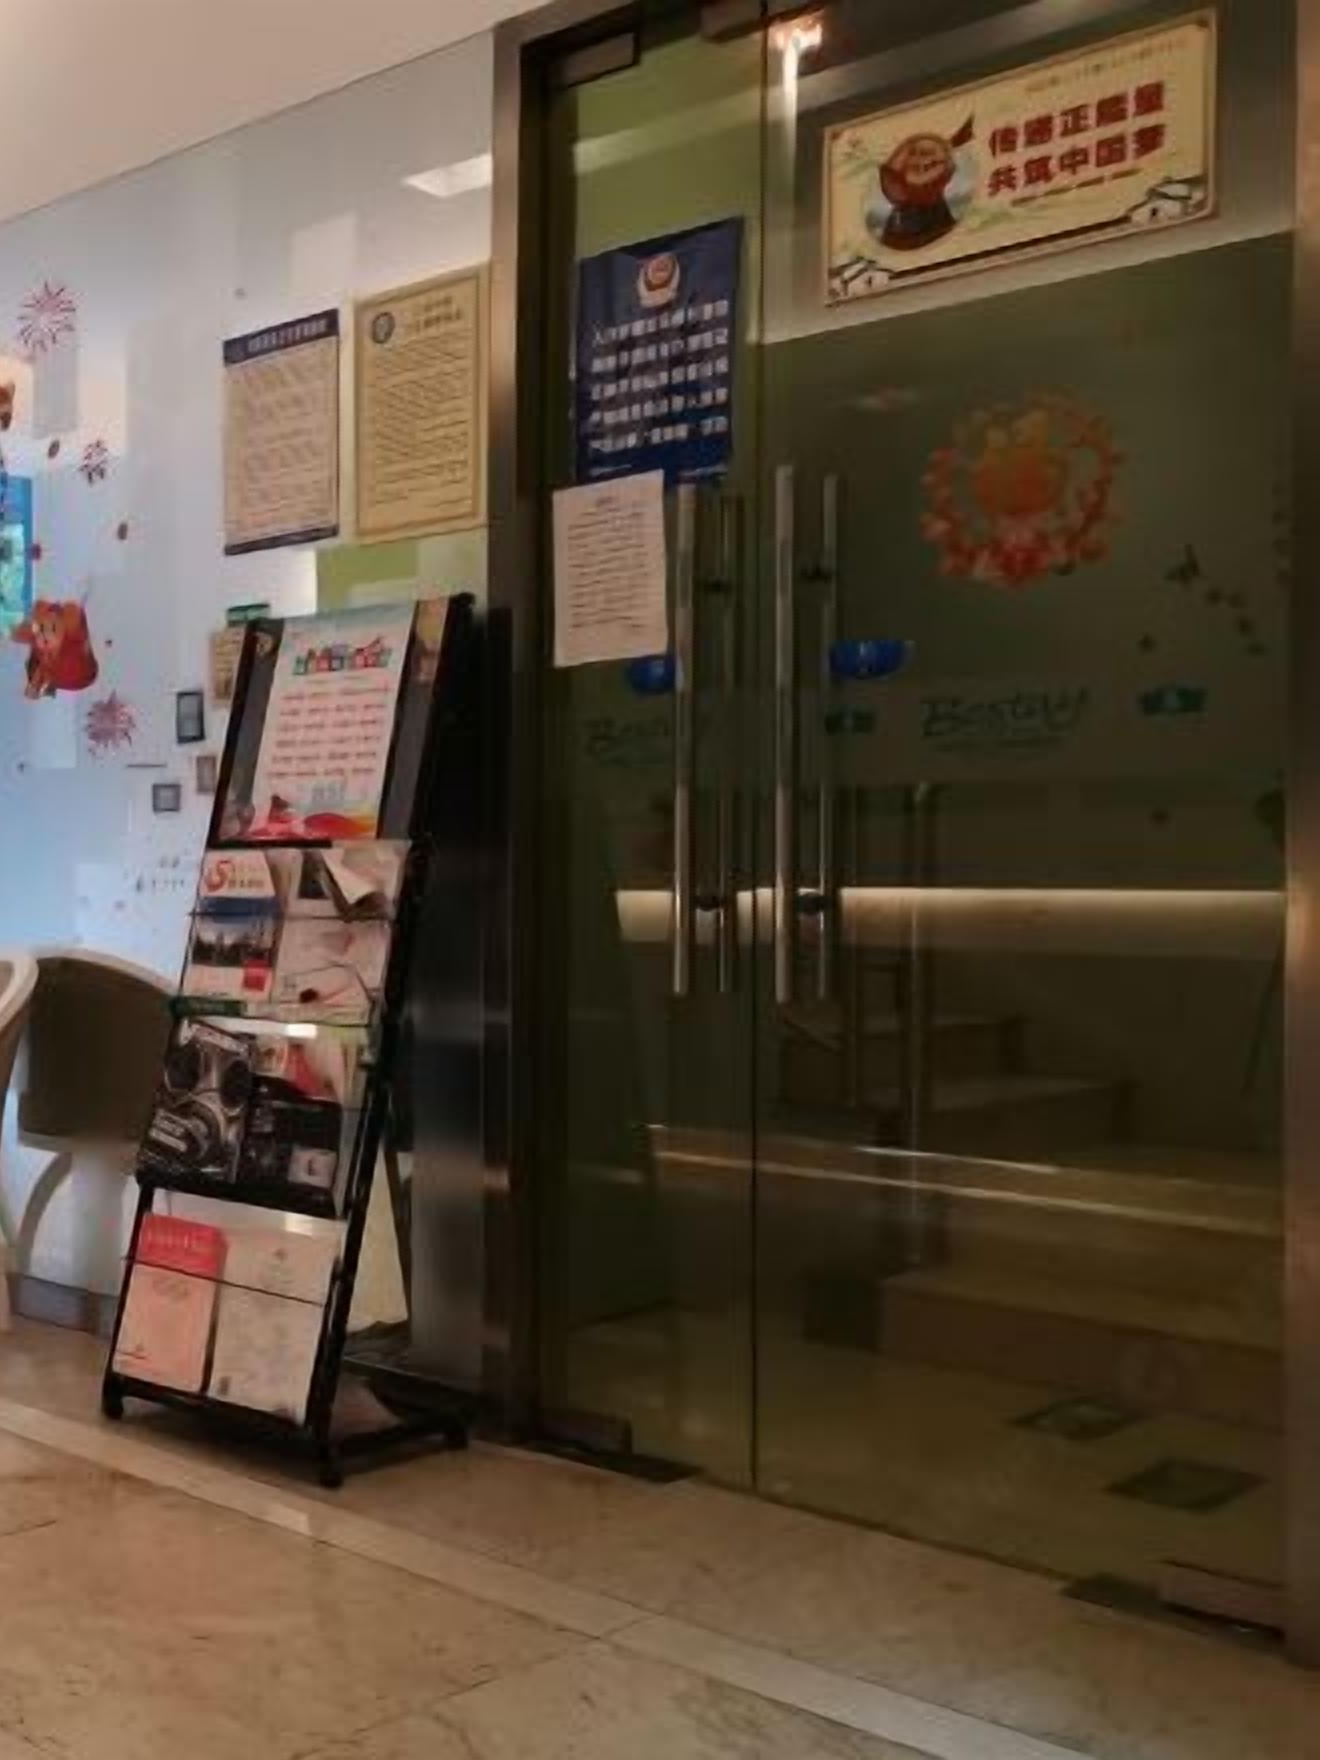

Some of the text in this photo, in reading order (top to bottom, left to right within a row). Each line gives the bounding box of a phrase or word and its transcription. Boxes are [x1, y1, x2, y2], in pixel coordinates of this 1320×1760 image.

[988, 123, 1166, 197] 共筑中国梦
